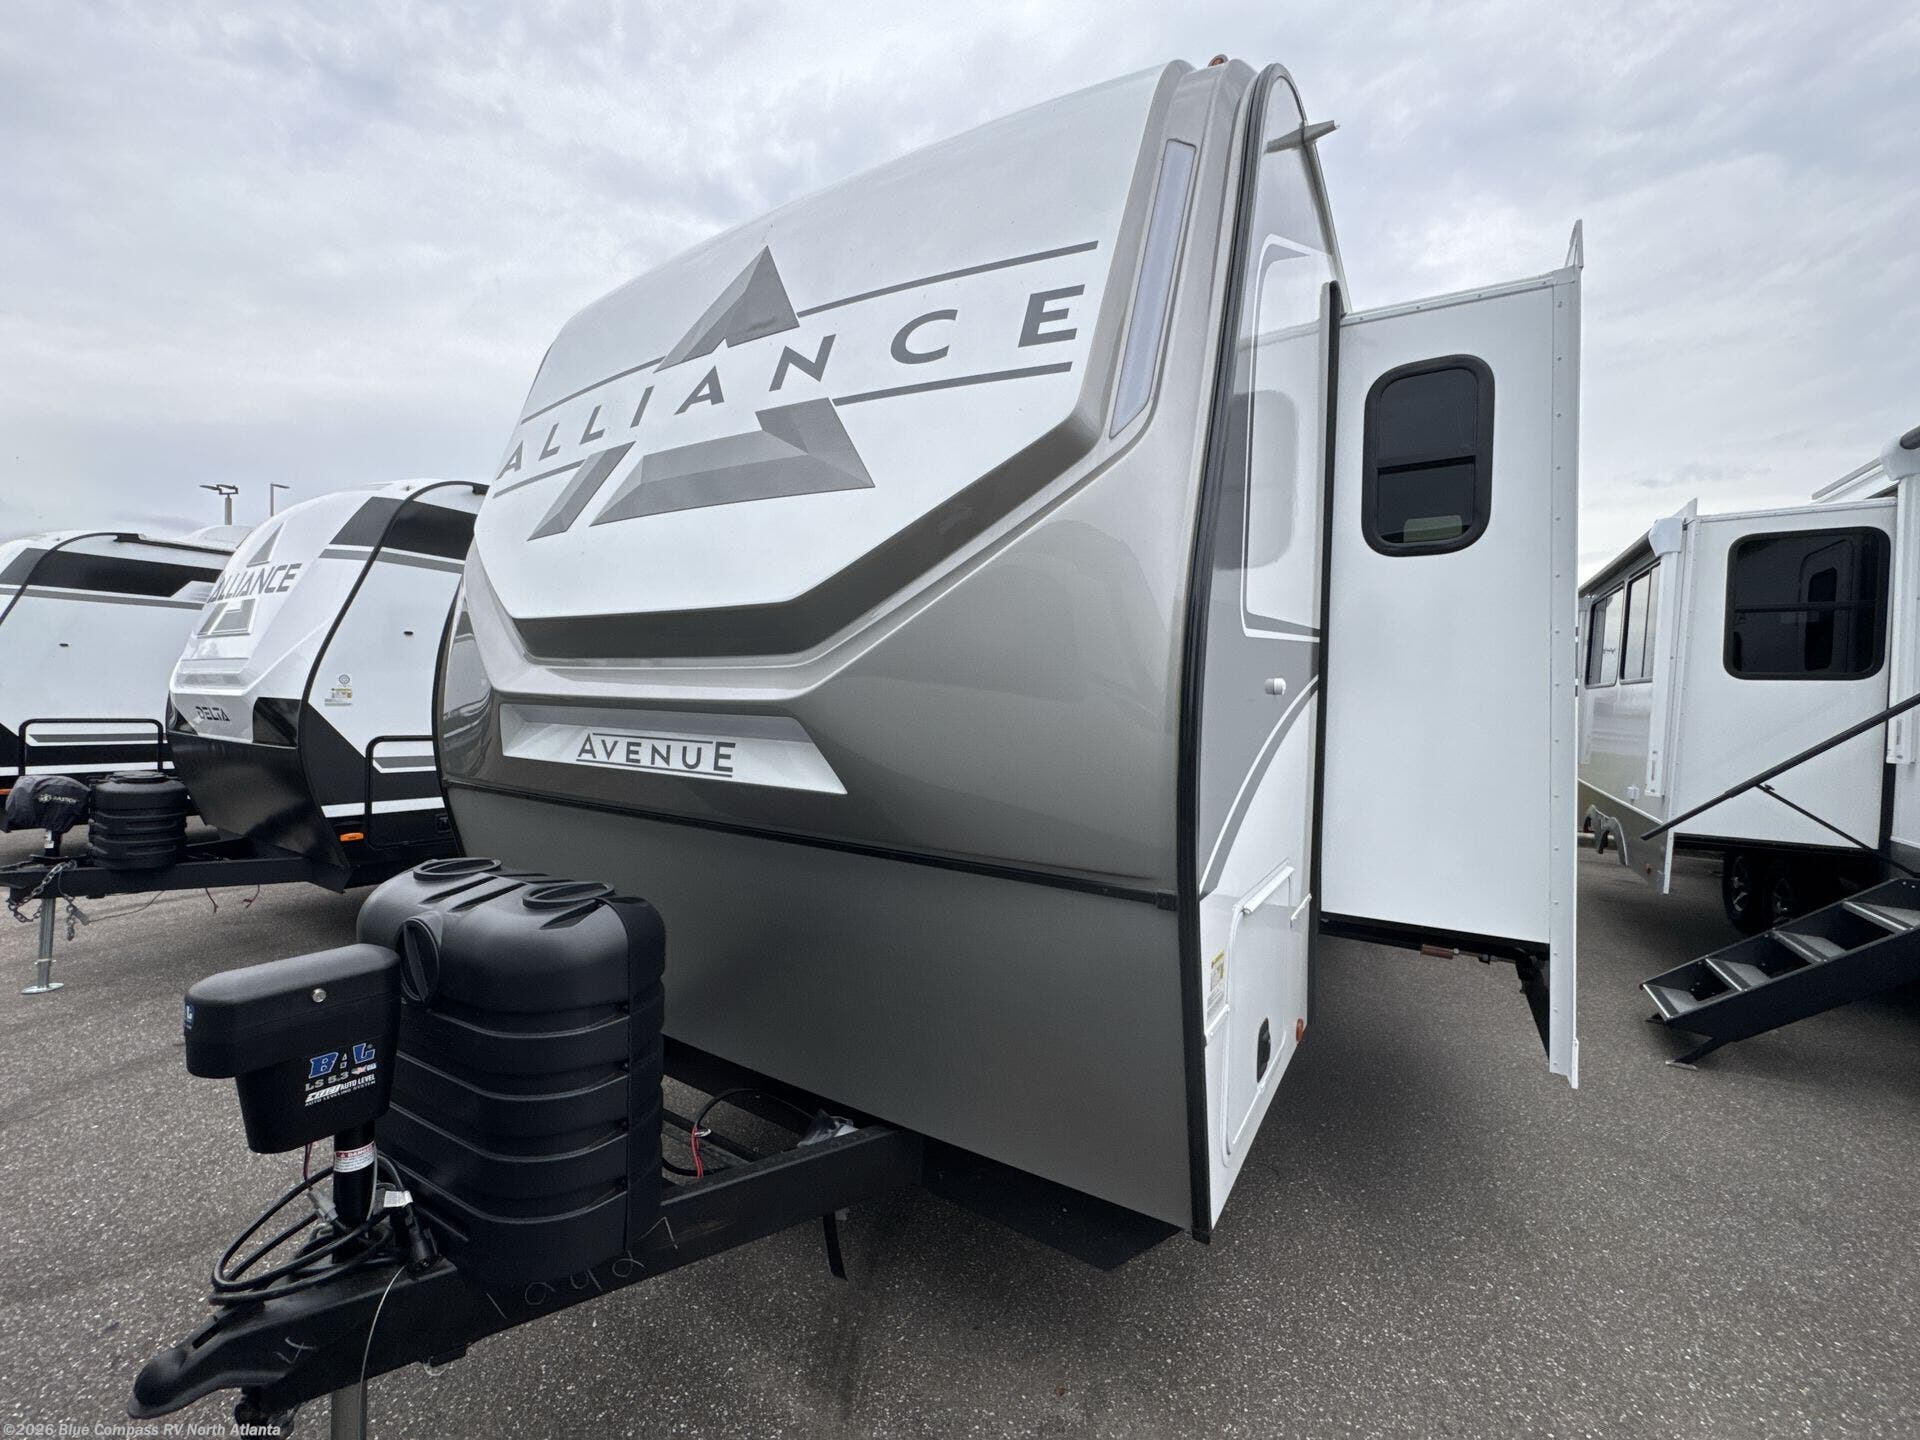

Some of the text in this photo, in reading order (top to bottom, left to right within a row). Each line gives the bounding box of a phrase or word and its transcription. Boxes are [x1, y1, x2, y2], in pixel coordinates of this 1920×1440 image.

[496, 284, 1086, 480] ALLIANCE
[207, 563, 303, 604] ALLIANCE
[195, 705, 231, 721] DELTA
[577, 733, 737, 773] AVENUE
[340, 1079, 357, 1091] AUTO
